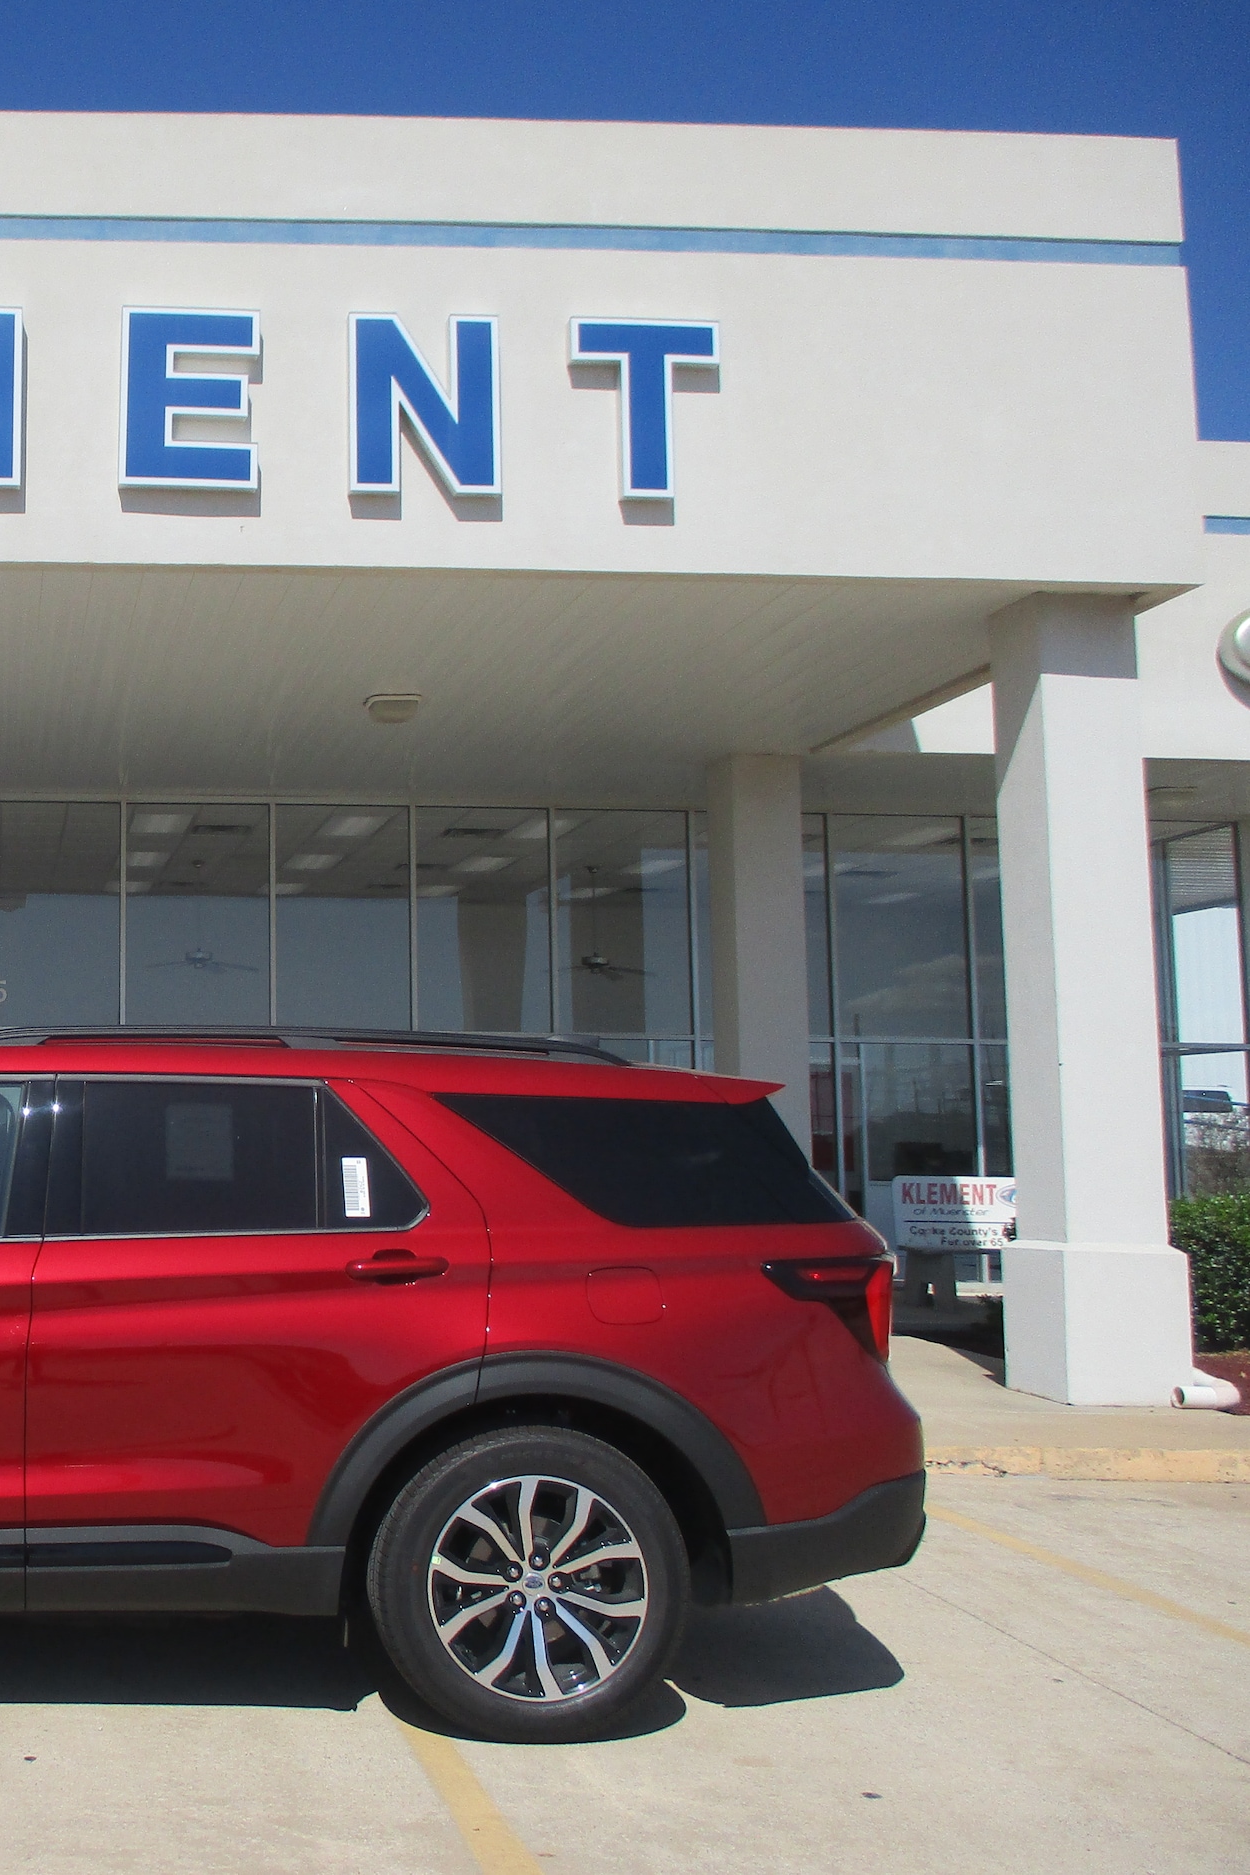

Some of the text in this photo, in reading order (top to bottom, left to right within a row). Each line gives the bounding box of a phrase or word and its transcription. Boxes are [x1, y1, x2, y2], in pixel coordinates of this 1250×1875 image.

[902, 1183, 997, 1205] KLEMENT
[913, 1207, 989, 1216] of Muenster
[909, 1225, 998, 1238] Coke County's
[991, 1237, 1004, 1247] 65
